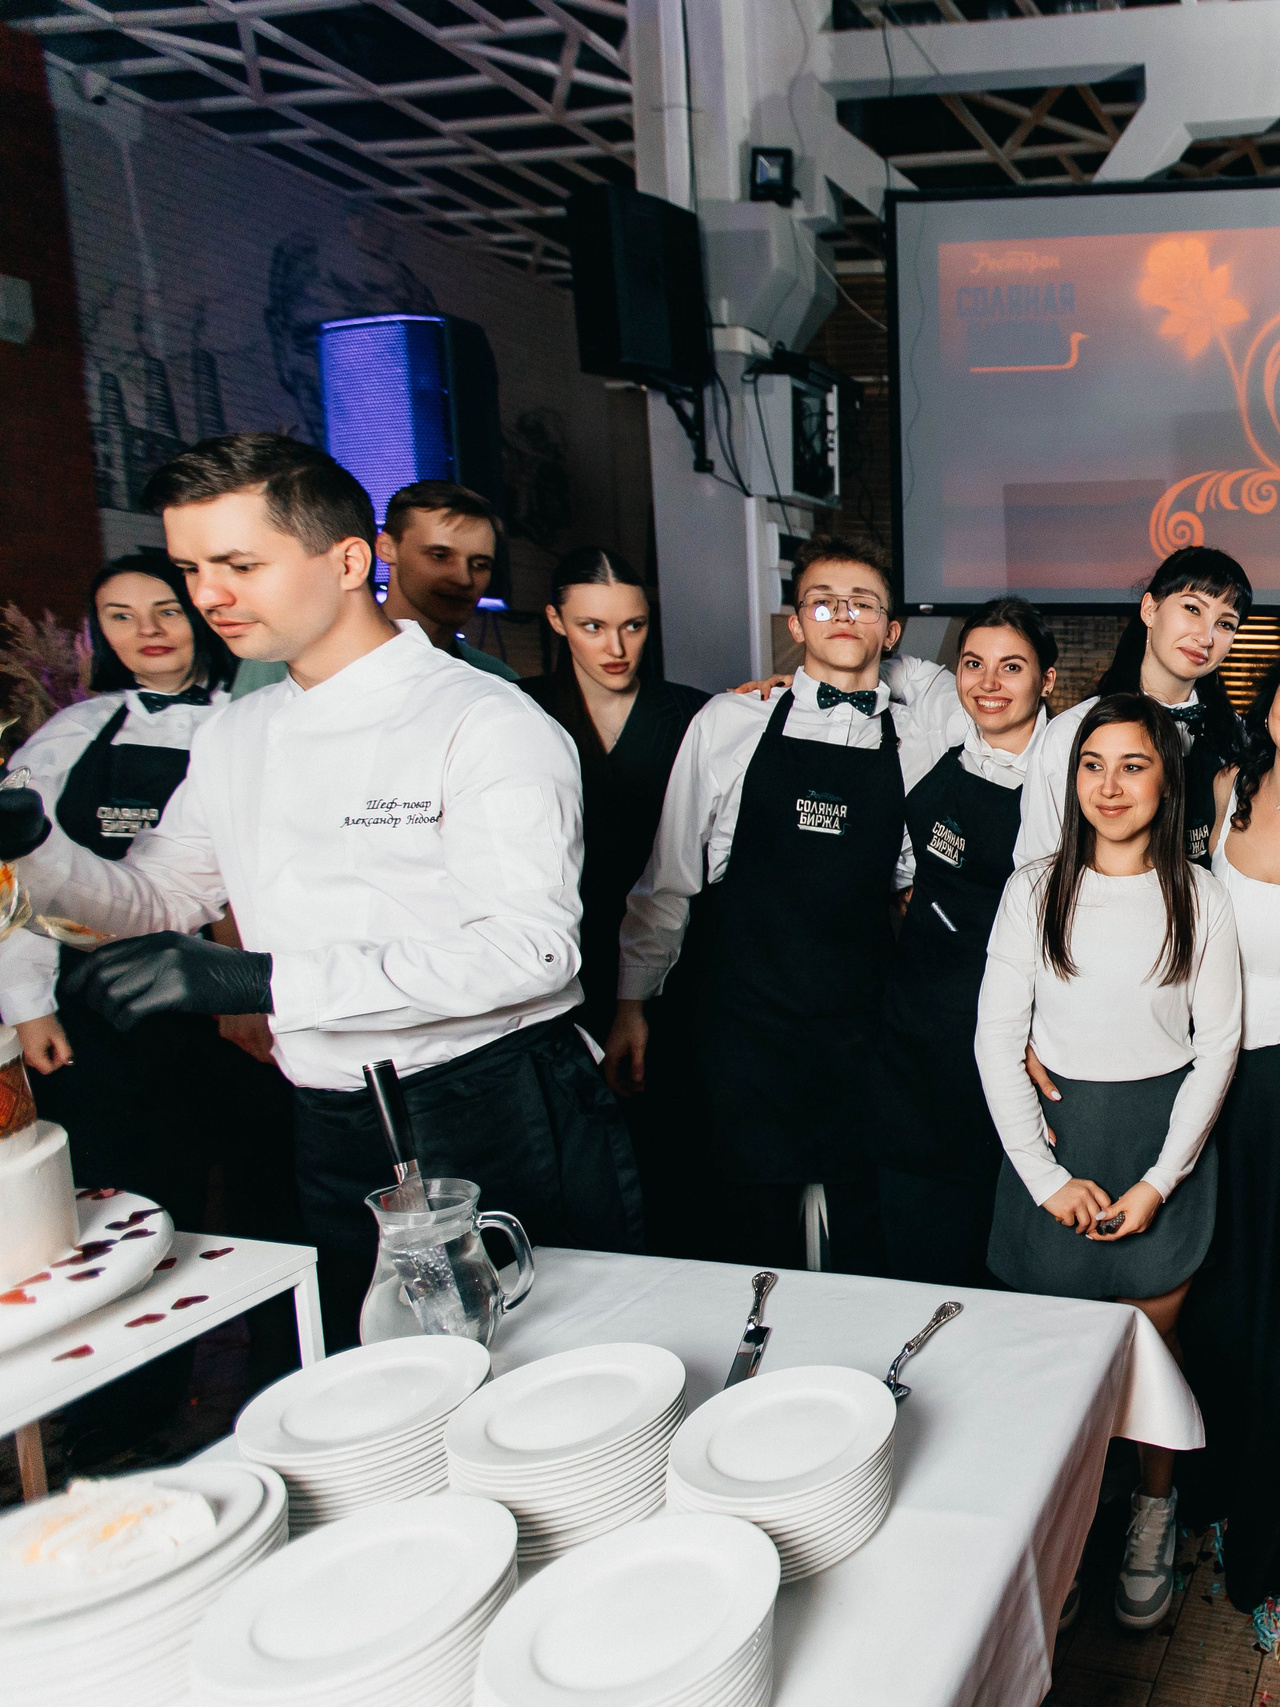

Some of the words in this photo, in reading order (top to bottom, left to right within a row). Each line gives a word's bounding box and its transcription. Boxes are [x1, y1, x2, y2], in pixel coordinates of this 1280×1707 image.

[956, 281, 1076, 319] СОЛЯНАЯ
[796, 798, 848, 819] СОЛЯНАЯ
[799, 812, 841, 829] БИРЖА
[930, 834, 959, 862] БИРЖА
[932, 821, 966, 852] СОЛЯНАЯ
